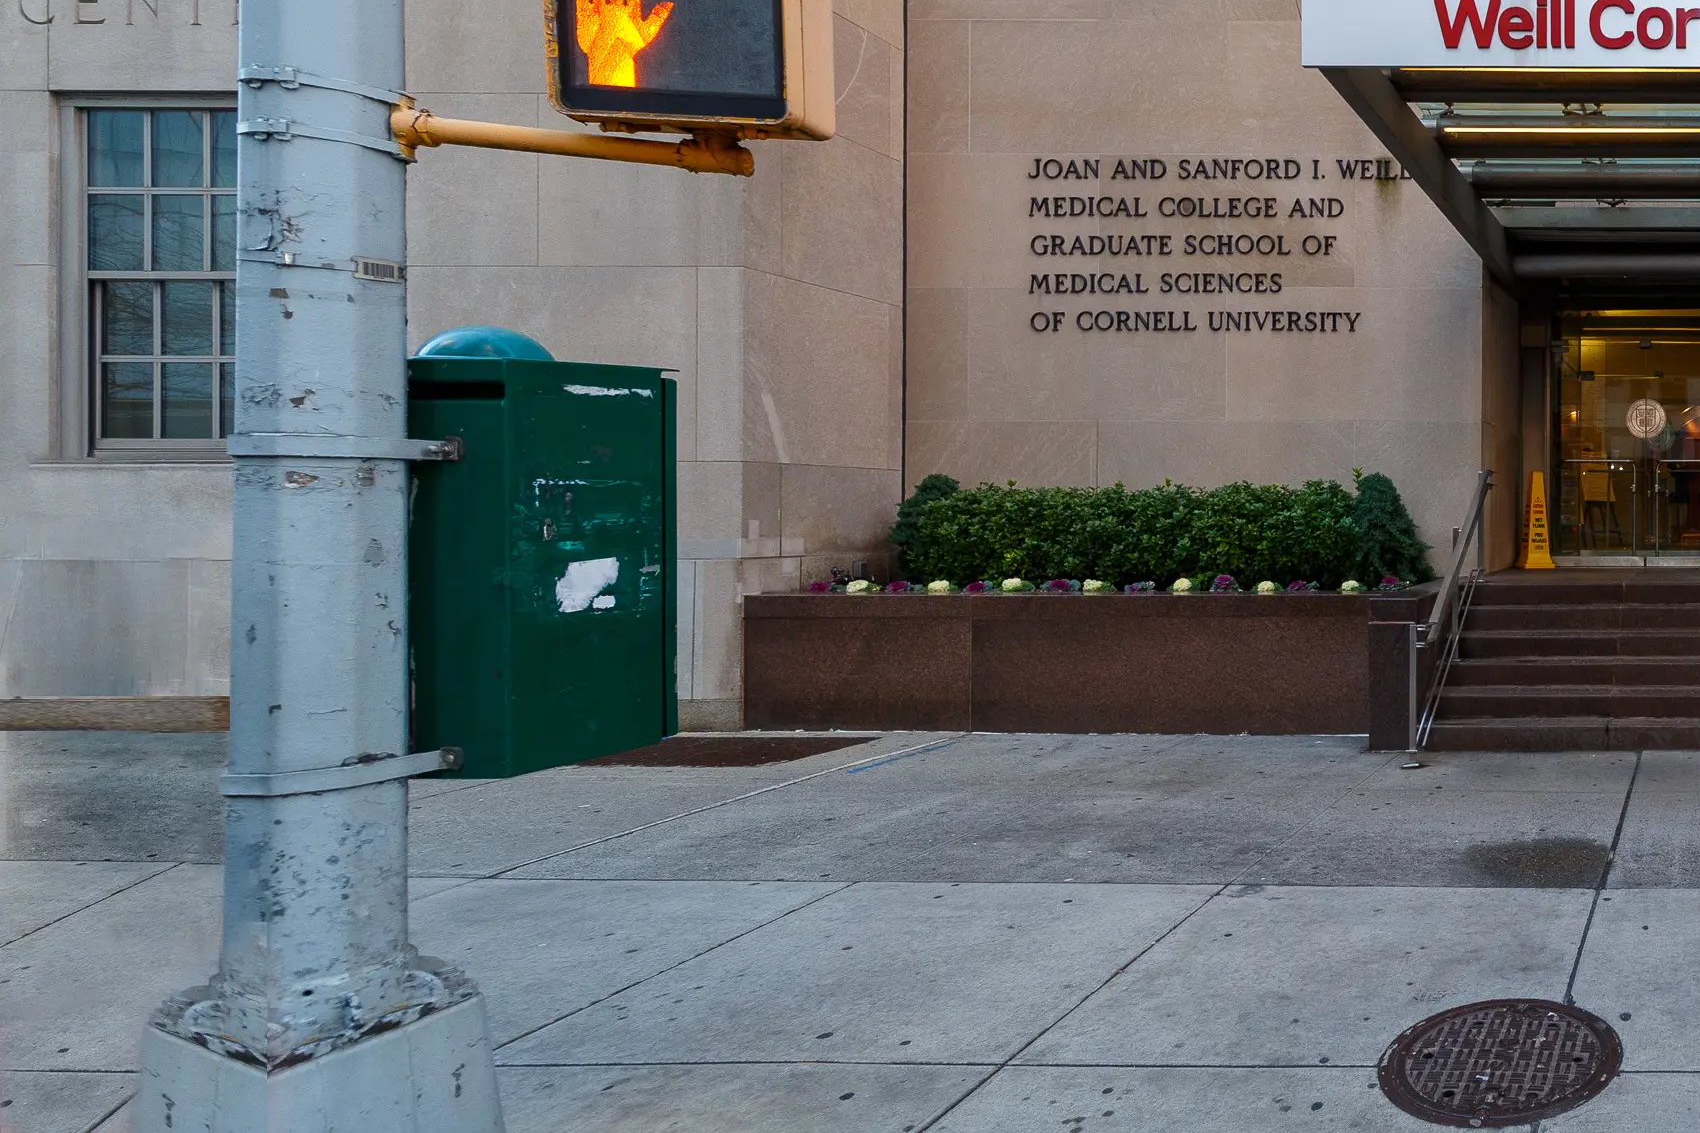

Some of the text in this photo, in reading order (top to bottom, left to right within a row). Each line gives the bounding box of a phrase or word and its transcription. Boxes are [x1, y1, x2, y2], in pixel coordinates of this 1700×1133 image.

[1028, 159, 1100, 179] JOAN
[1111, 159, 1167, 179] AND
[1178, 159, 1300, 179] SANFORD
[1312, 159, 1325, 179] I.
[1029, 197, 1344, 218] MEDICAL COLLEGE AND
[1030, 235, 1337, 255] GRADUATE SCHOOL OF
[1029, 273, 1282, 294] MEDICAL SCIENCES
[1030, 311, 1361, 332] OF CORNELL UNIVERSITY
